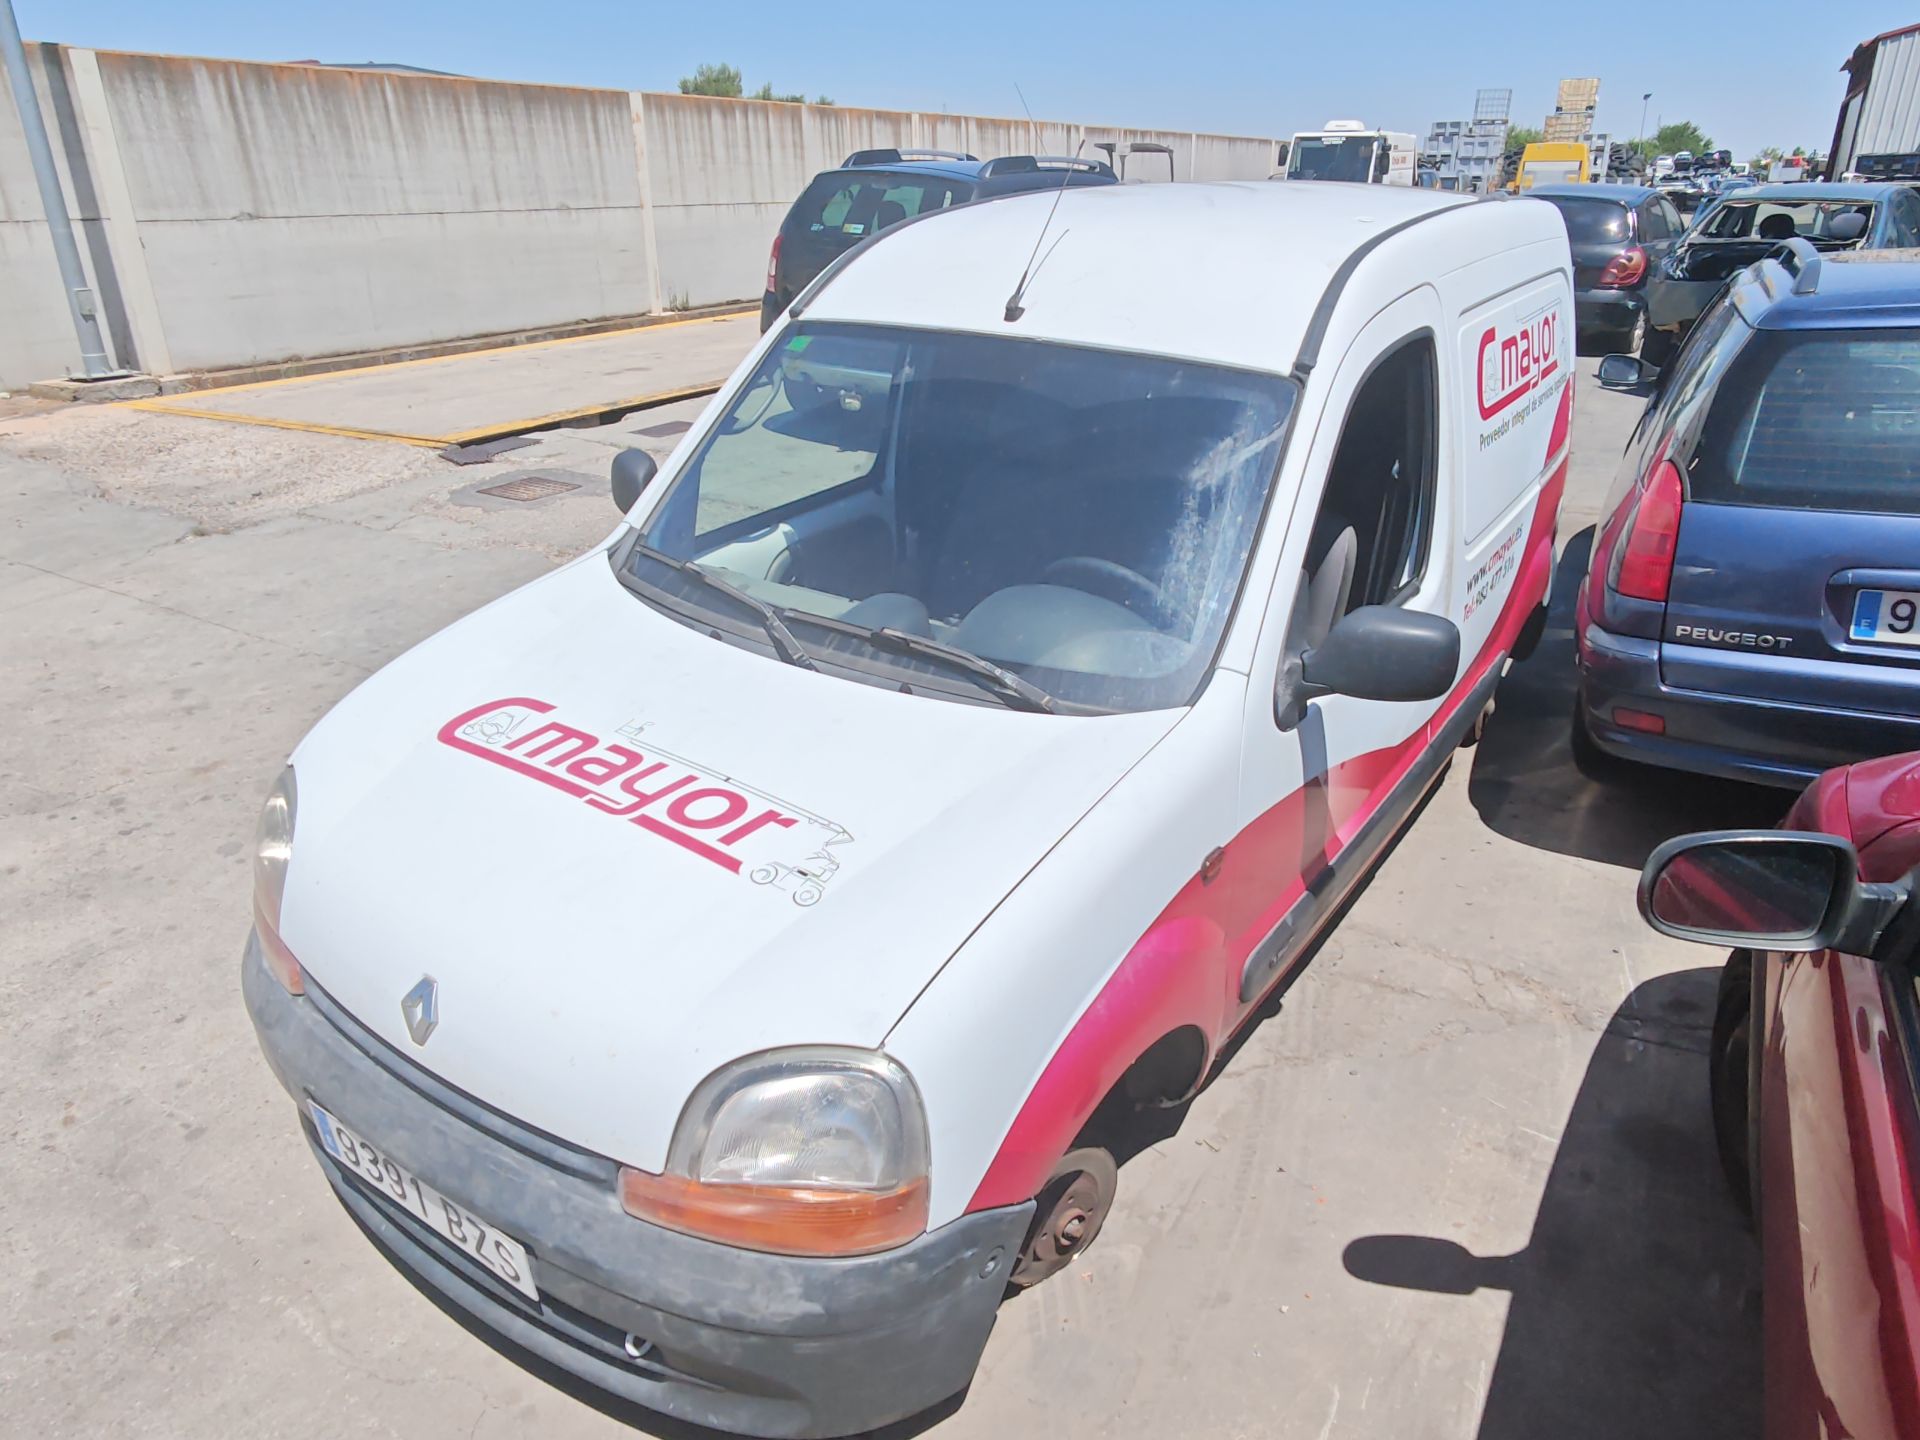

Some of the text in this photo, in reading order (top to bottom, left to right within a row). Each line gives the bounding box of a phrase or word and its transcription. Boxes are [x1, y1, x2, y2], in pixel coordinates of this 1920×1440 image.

[1480, 418, 1510, 452] Proveedor
[1511, 398, 1531, 425] integral
[1675, 625, 1793, 650] PEUGEOT
[1861, 618, 1872, 630] E
[335, 1126, 522, 1283] 9391 BZS
